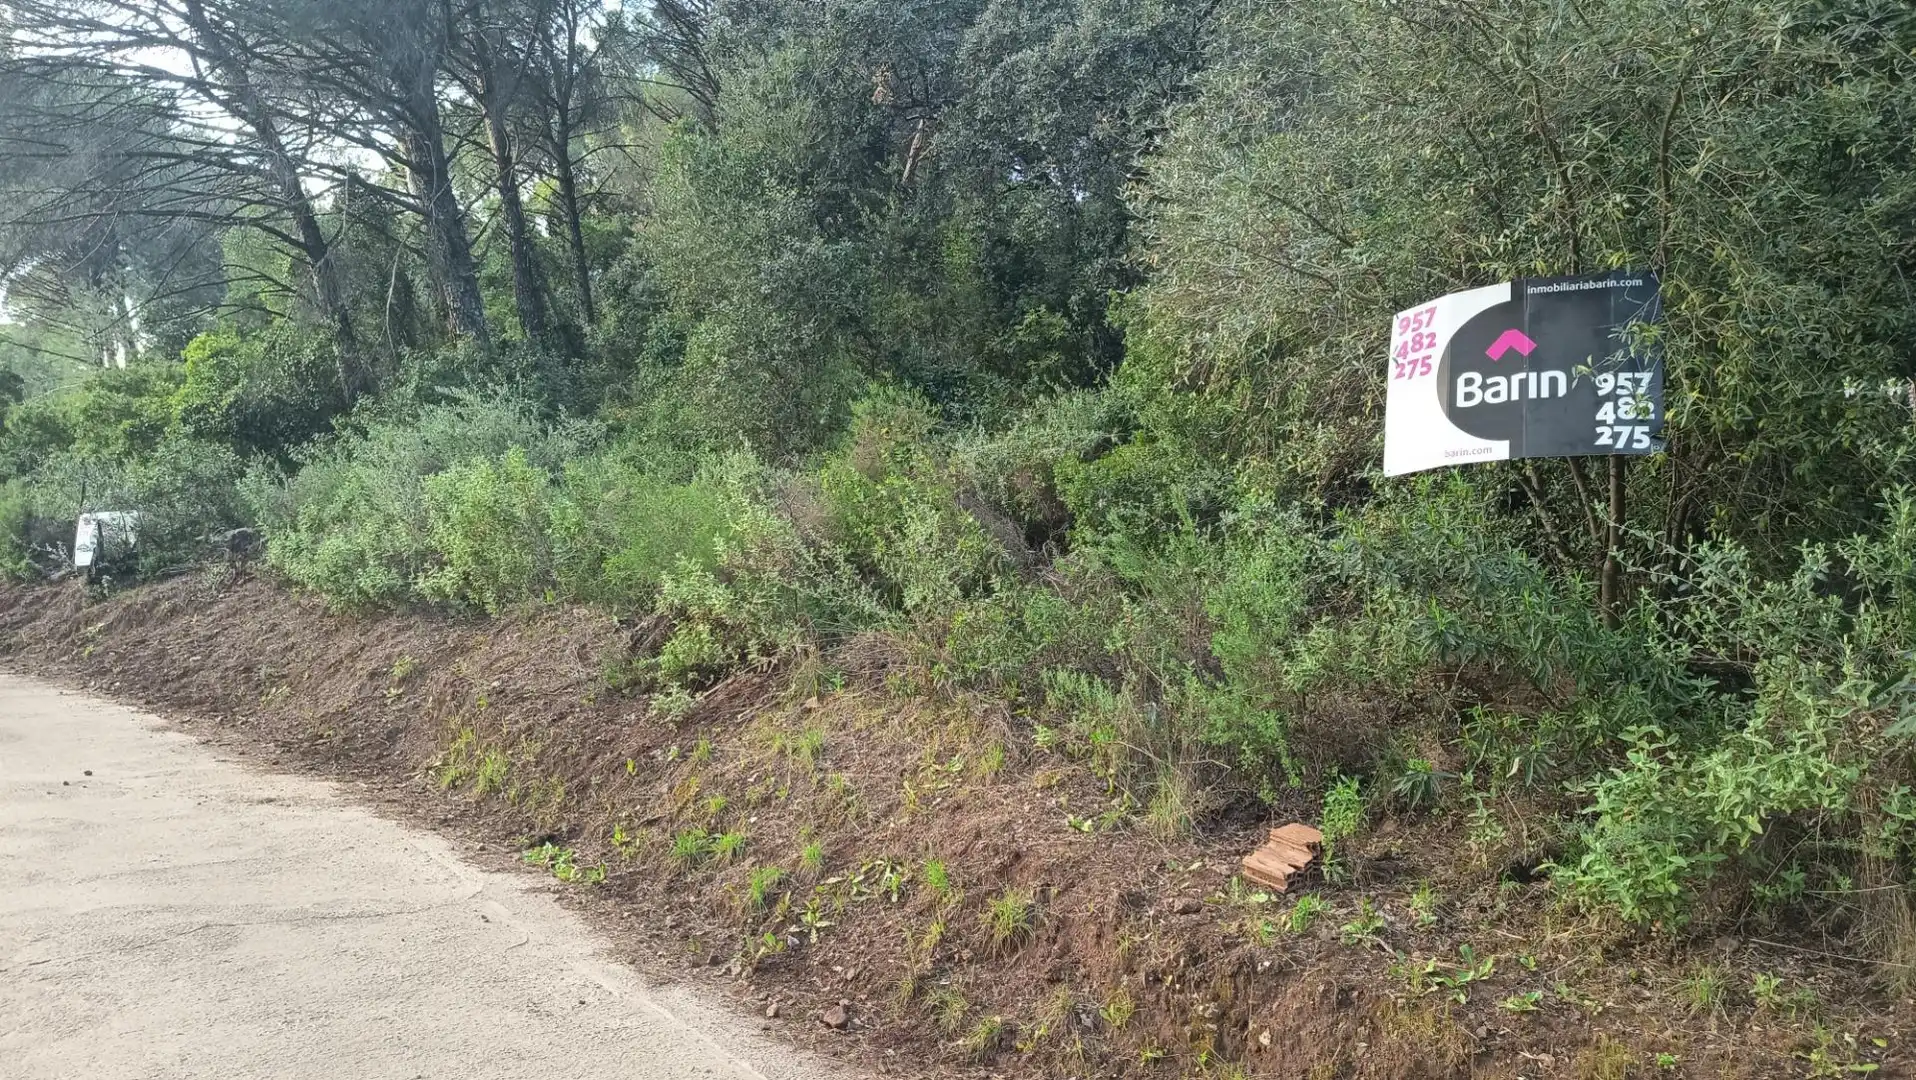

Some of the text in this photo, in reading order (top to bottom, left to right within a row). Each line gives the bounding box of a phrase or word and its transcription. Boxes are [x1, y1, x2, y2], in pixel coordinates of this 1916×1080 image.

[1527, 279, 1643, 294] inmobiliariabarin.com
[1398, 306, 1437, 336] 957
[1396, 332, 1437, 360] 482
[1394, 354, 1432, 380] 275
[1456, 370, 1567, 408] Barin
[1595, 372, 1654, 397] 957
[1595, 396, 1655, 424] 482
[1594, 425, 1651, 449] 275
